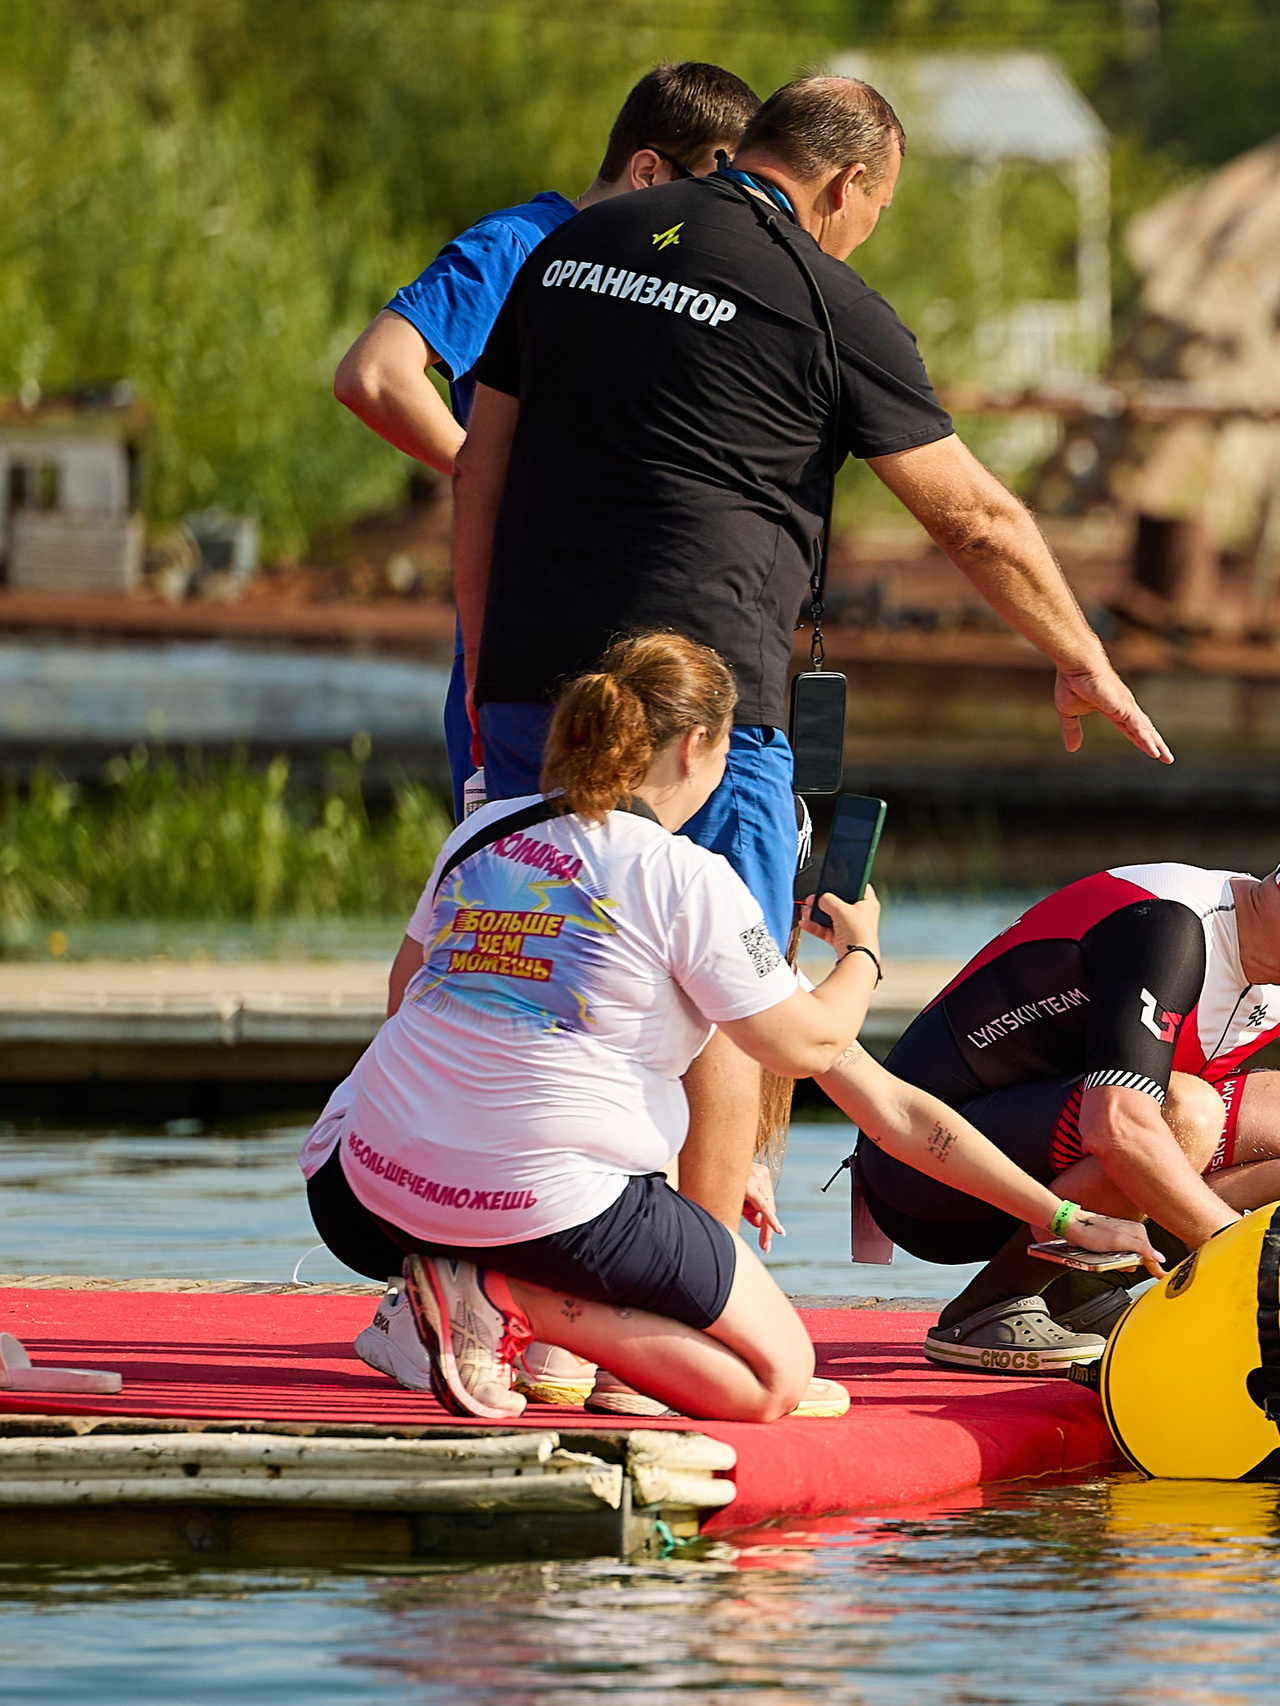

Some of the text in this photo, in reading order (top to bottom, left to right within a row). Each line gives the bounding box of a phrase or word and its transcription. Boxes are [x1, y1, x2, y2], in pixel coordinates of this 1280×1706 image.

[542, 260, 737, 327] ОРГАНИЗАТОР
[454, 910, 562, 937] БОЛЬШЕ
[477, 934, 523, 956] ЧЕМ
[447, 952, 549, 980] МОЖЕШЬ
[967, 988, 1090, 1049] LYATSKIY TEAM
[348, 1131, 539, 1211] #БОЛЬШЕЧЕММОЖЕШЬ
